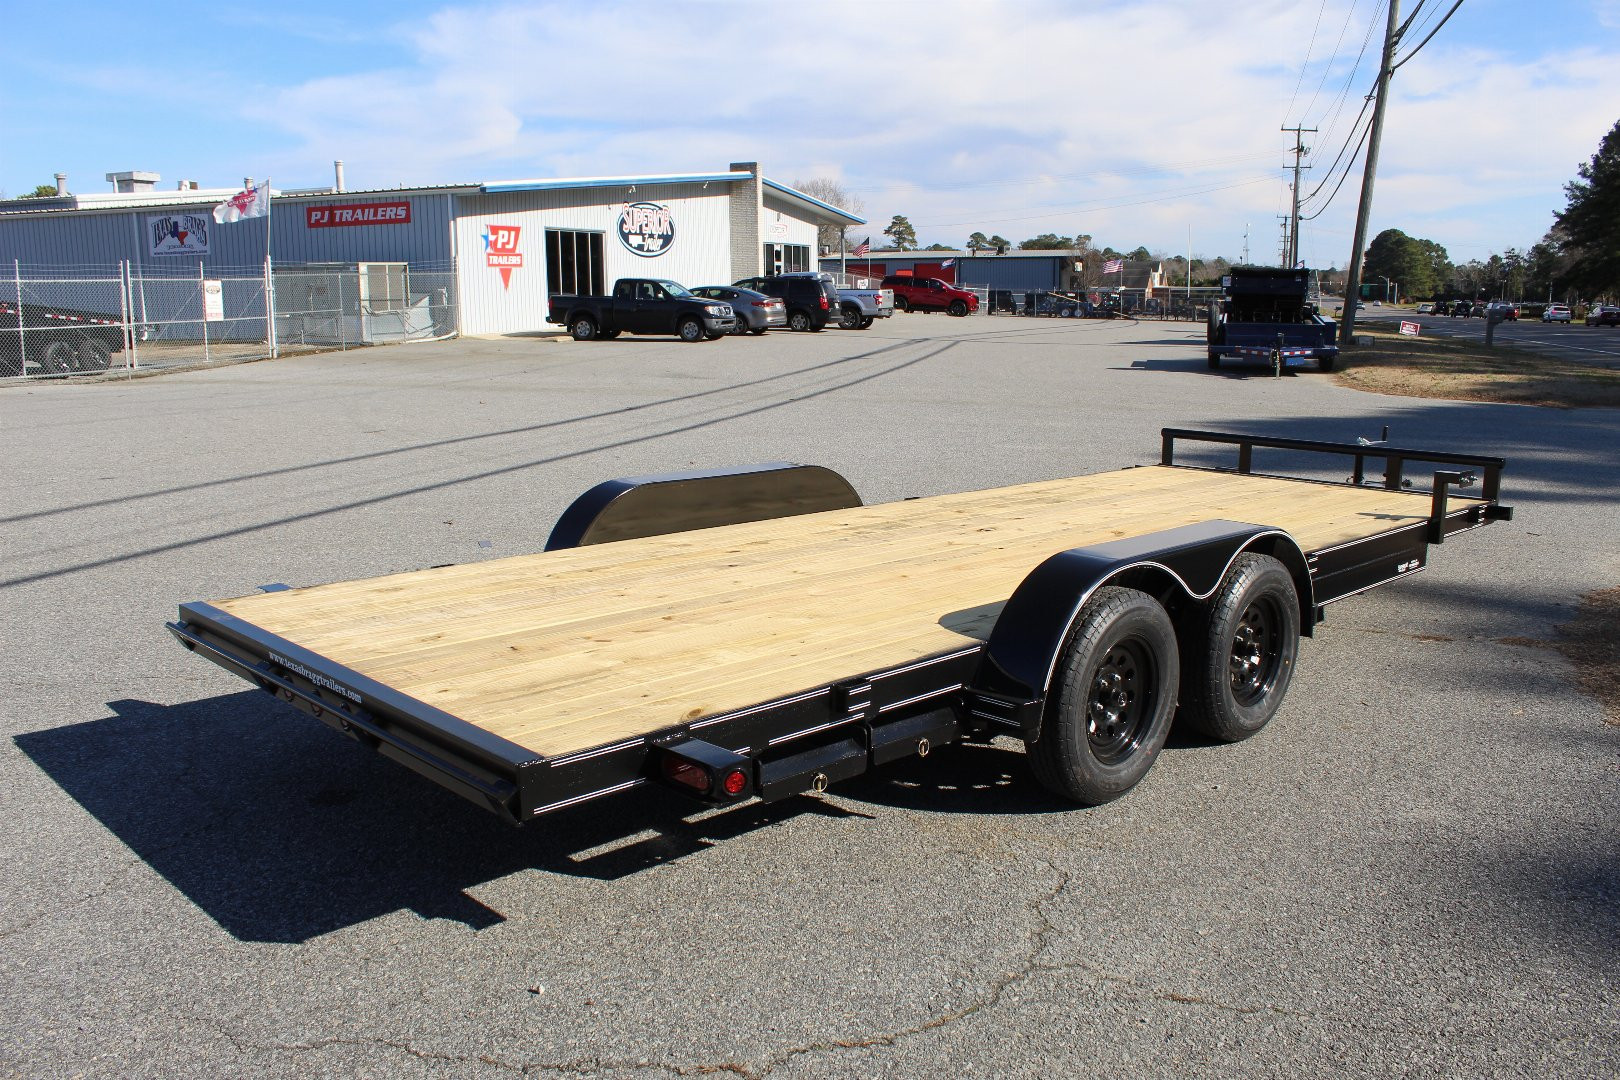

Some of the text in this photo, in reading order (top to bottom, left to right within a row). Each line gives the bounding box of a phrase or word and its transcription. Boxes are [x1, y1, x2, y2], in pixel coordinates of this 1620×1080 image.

[311, 207, 407, 223] PJ TRAILERS
[622, 202, 671, 236] SUPERIOR
[151, 216, 173, 249] TEXAS
[496, 230, 516, 249] PJ
[488, 255, 521, 265] TRAILERS
[268, 651, 362, 704] www.texasbraggtrailers.com
